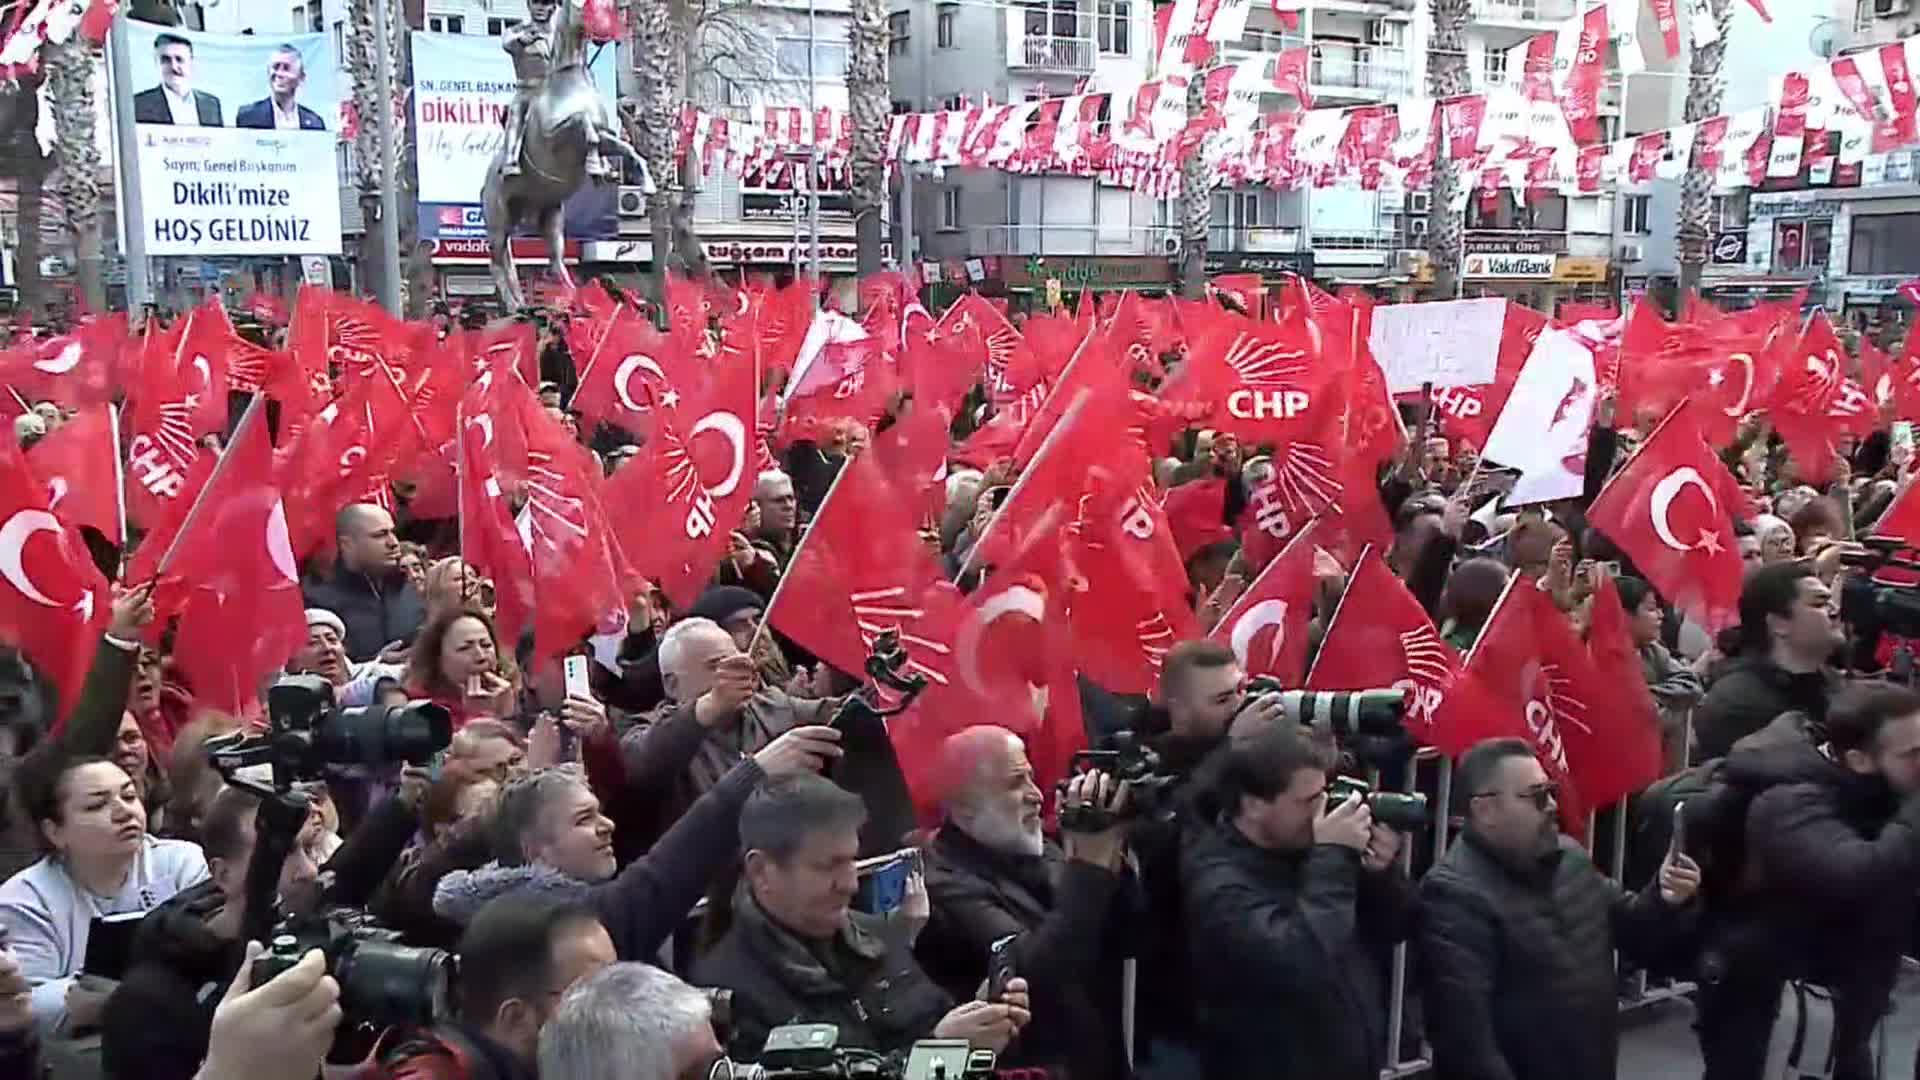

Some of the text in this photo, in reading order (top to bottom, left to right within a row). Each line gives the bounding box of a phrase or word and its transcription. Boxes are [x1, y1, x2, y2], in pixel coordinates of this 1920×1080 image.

[204, 158, 237, 173] Genel
[173, 181, 290, 206] Dikili'mize
[155, 214, 312, 245] HOŞ GELDİNİZ
[1227, 389, 1310, 420] CHP
[1430, 384, 1484, 419] CHP
[129, 434, 185, 497] CHP
